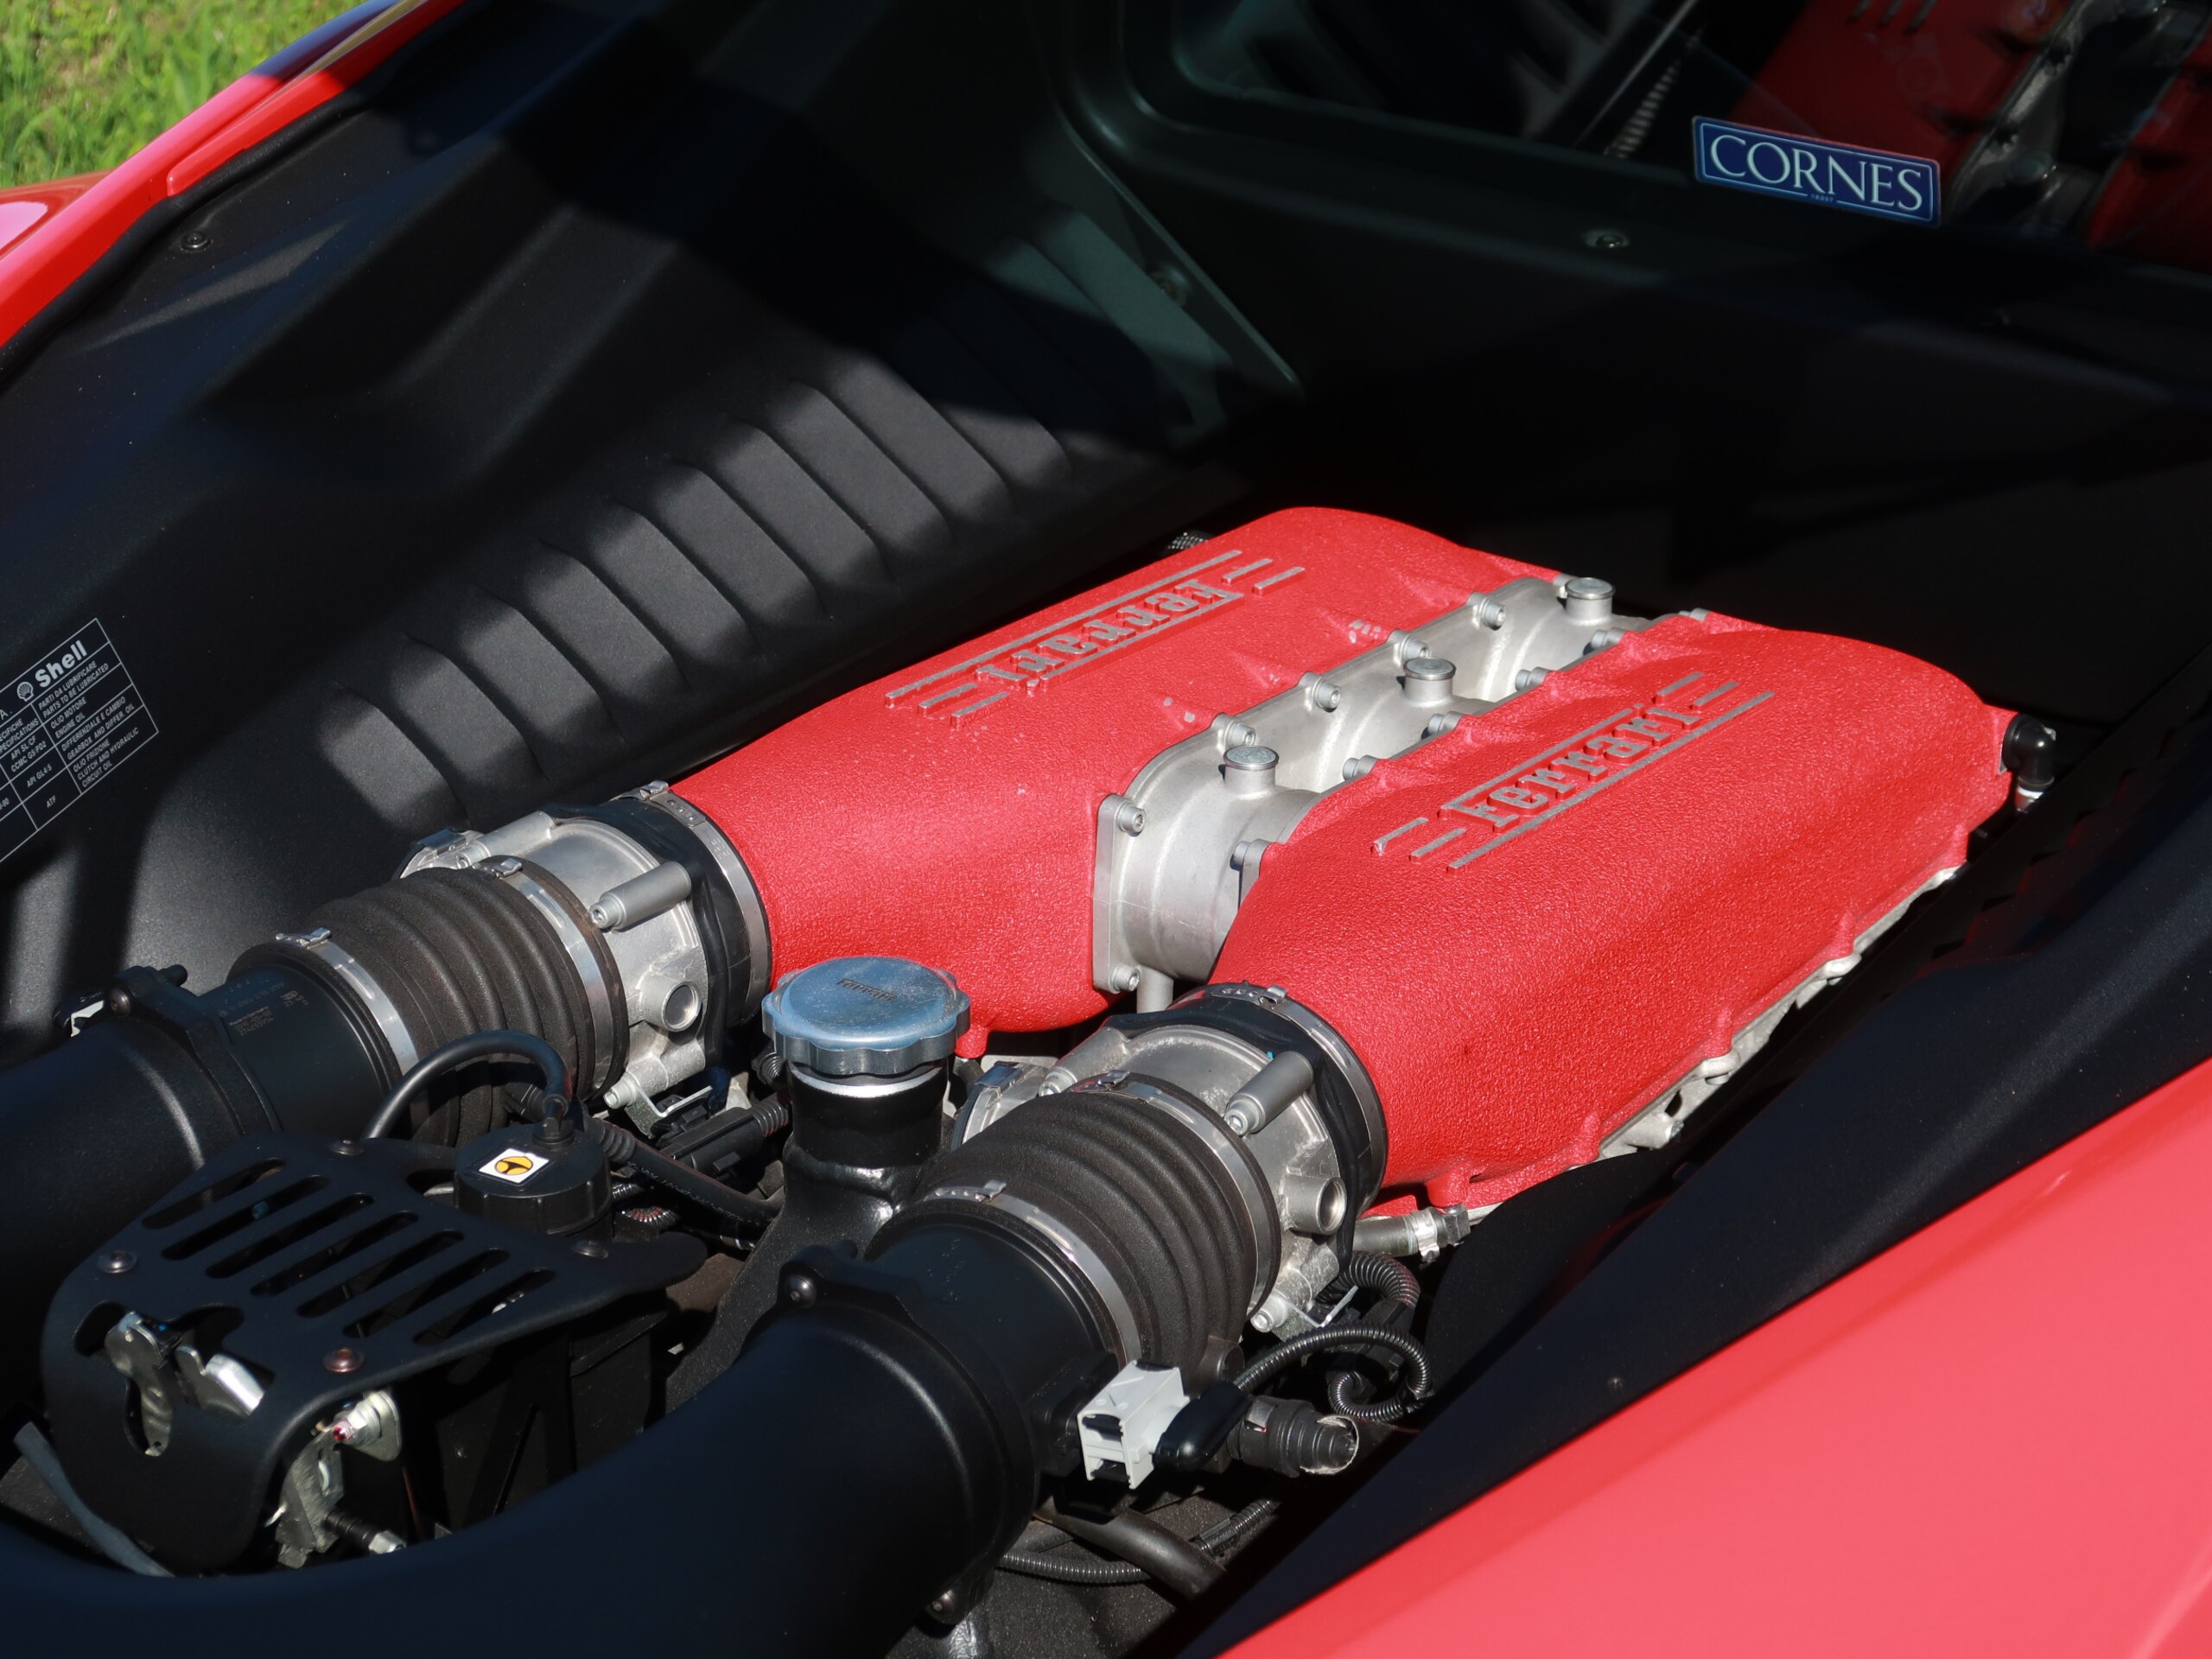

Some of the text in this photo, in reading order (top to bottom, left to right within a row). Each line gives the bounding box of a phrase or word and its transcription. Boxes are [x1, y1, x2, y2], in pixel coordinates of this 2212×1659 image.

[1710, 135, 1923, 211] CORNES
[35, 640, 88, 688] Shell
[38, 660, 97, 710] PARTI DA LUBRIFICARE
[42, 663, 109, 718] PARTS TO BE LUBRICATED
[50, 696, 86, 729] OLIO MOTORE
[54, 712, 86, 739] ENGINE OIL
[61, 696, 126, 752] DIFFERENZIALE E CAMBIO
[67, 736, 92, 760] GEARBOX
[93, 726, 105, 739] AND
[124, 703, 135, 714] OIL
[11, 748, 21, 760] API
[11, 756, 28, 772] CCMC
[73, 739, 110, 772] OLIO FRIZIONE
[77, 727, 138, 780] CLUTCH AND HYDRAULIC
[1440, 702, 1701, 827] Ferrari
[27, 776, 36, 788] API
[82, 760, 112, 788] CIRCUIT OIL
[47, 795, 56, 809] ATF
